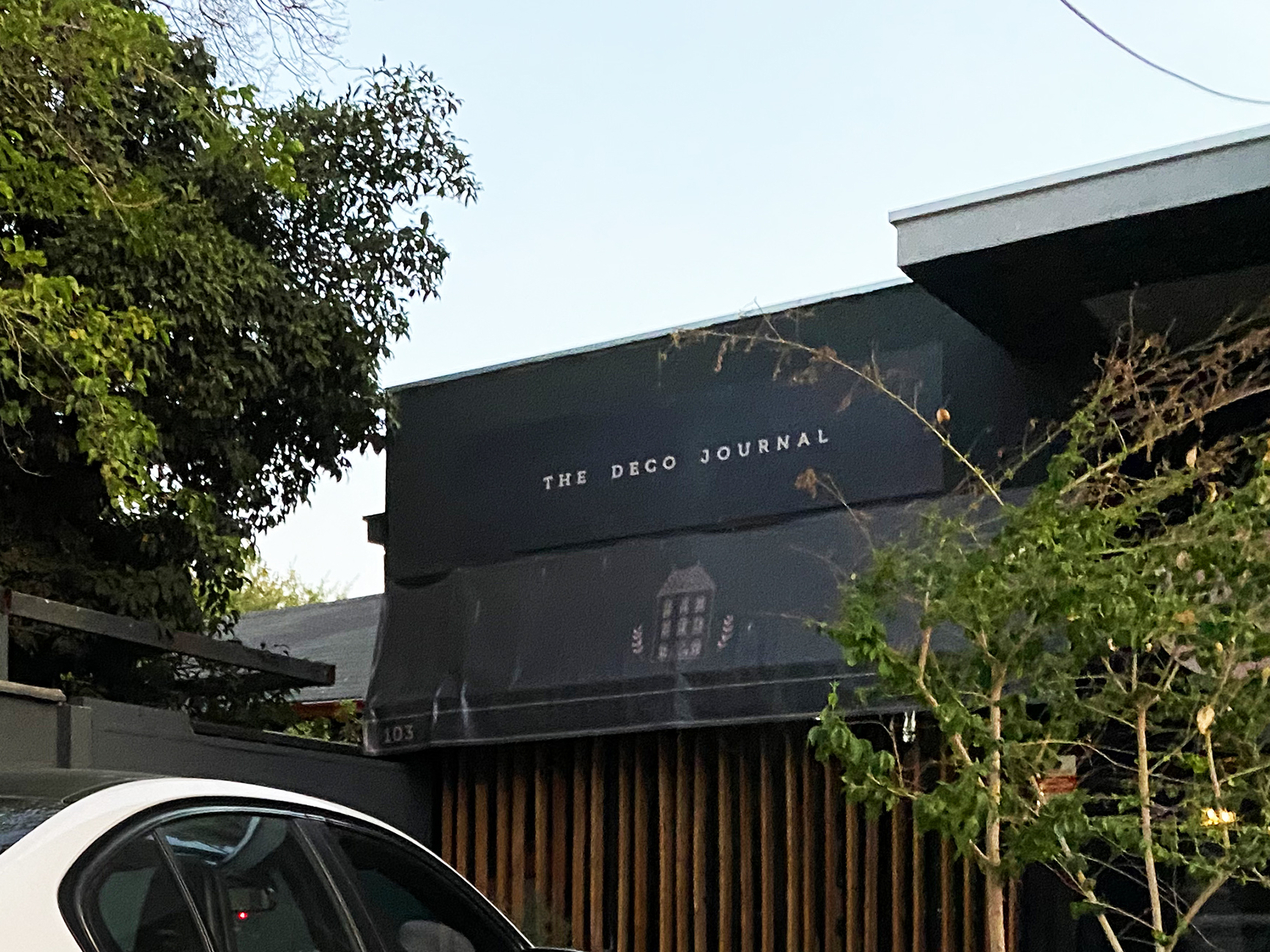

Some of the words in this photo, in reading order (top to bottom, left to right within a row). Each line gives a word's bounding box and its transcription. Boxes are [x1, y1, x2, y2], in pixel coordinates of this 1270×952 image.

[543, 470, 587, 490] THE
[611, 455, 677, 479] DECO
[700, 429, 829, 464] JOURNAL
[384, 725, 414, 743] 103
